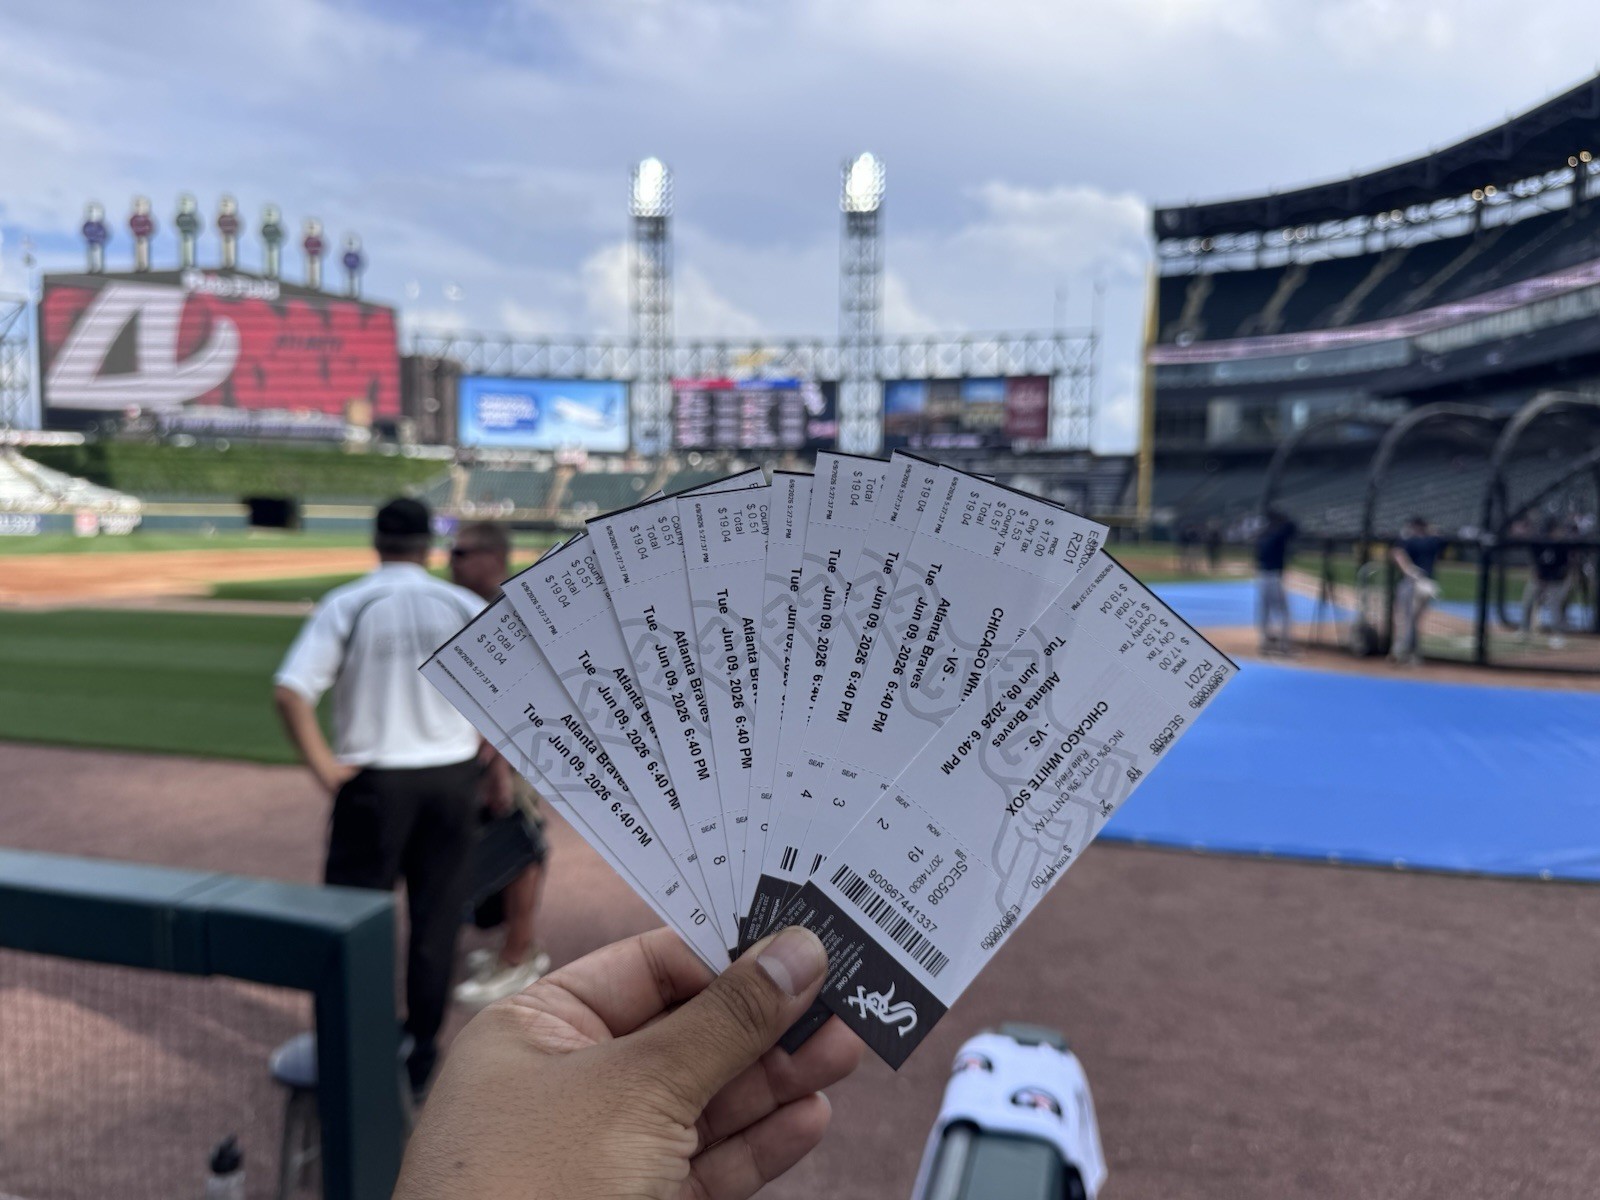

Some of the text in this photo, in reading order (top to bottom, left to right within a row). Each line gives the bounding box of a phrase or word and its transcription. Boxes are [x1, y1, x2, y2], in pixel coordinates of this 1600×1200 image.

[864, 478, 876, 503] Total
[733, 510, 745, 535] Total
[826, 510, 832, 520] PM
[890, 512, 898, 522] PM
[976, 502, 991, 526] Total
[646, 525, 661, 550] Total
[934, 524, 942, 533] PM
[993, 508, 1016, 556] County Tax
[1011, 521, 1025, 541] 1.53
[1020, 518, 1039, 553] City Tax
[1034, 531, 1050, 557] 17.00
[1047, 537, 1059, 555] PRICE
[1063, 532, 1083, 564] RZ01
[827, 549, 840, 573] Tue
[561, 570, 581, 596] Total
[584, 556, 608, 592] County
[790, 567, 802, 592] Tue
[822, 585, 835, 611] Jun
[1071, 601, 1080, 611] PM
[1114, 597, 1136, 620] Total
[548, 625, 558, 635] PM
[817, 614, 831, 632] 09,
[1118, 613, 1157, 654] County Tax
[493, 627, 515, 652] Total
[742, 617, 758, 664] Atlanta
[836, 552, 899, 723] Tue Jun 09, 2026 6:40 PM
[871, 564, 942, 733] Tue Jun 09, 2026 6:40 PM
[910, 597, 951, 689] Atlanta Braves
[974, 607, 1004, 669] CHICAGO
[1142, 628, 1161, 647] 1.53
[1146, 631, 1175, 661] City Tax
[815, 636, 828, 667] 2026
[1158, 647, 1181, 671] 17.00
[673, 631, 709, 723] Atlanta Braves
[943, 657, 958, 674] VS
[1171, 658, 1187, 674] PRICE
[1184, 659, 1213, 689] RZ01
[489, 684, 499, 693] PM
[612, 668, 644, 711] Atlanta
[717, 588, 752, 769] Tue Jun 09, 2026 6:40 PM
[643, 605, 710, 781] Tue Jun 09, 2026 6:40 PM
[940, 636, 1066, 775] Tue Jun 09, 2026 6:40 PM
[992, 671, 1060, 748] Atlanta Braves
[560, 714, 597, 754] Atlanta
[578, 650, 681, 810] Tue Jun 09, 2026 6:40 PM
[1029, 730, 1048, 747] VS
[1108, 729, 1125, 746] INC
[808, 759, 824, 768] SEAT
[1005, 701, 1108, 816] CHICAGO WHITE SOX
[1096, 744, 1112, 758] 9%
[523, 703, 653, 847] Tue Jun 09, 2026 6:40 PM
[841, 769, 857, 779] SEAT
[1054, 749, 1090, 790] Rate Field
[801, 789, 813, 799] 4
[1067, 778, 1082, 793] 3%
[833, 797, 845, 808] 3
[895, 795, 910, 809] SEAT
[1048, 792, 1070, 817] CNTY
[701, 822, 716, 833] SEAT
[877, 817, 889, 830] 2
[927, 823, 940, 837] ROW
[1032, 816, 1051, 834] TAX
[713, 855, 726, 865] 8
[908, 846, 924, 863] 19
[909, 854, 943, 894] 20714830
[927, 860, 968, 905] SEC508
[665, 881, 680, 896] SEAT
[868, 869, 938, 932] 900967441337
[690, 908, 706, 925] 10
[835, 958, 863, 990] ADMIT ONE
